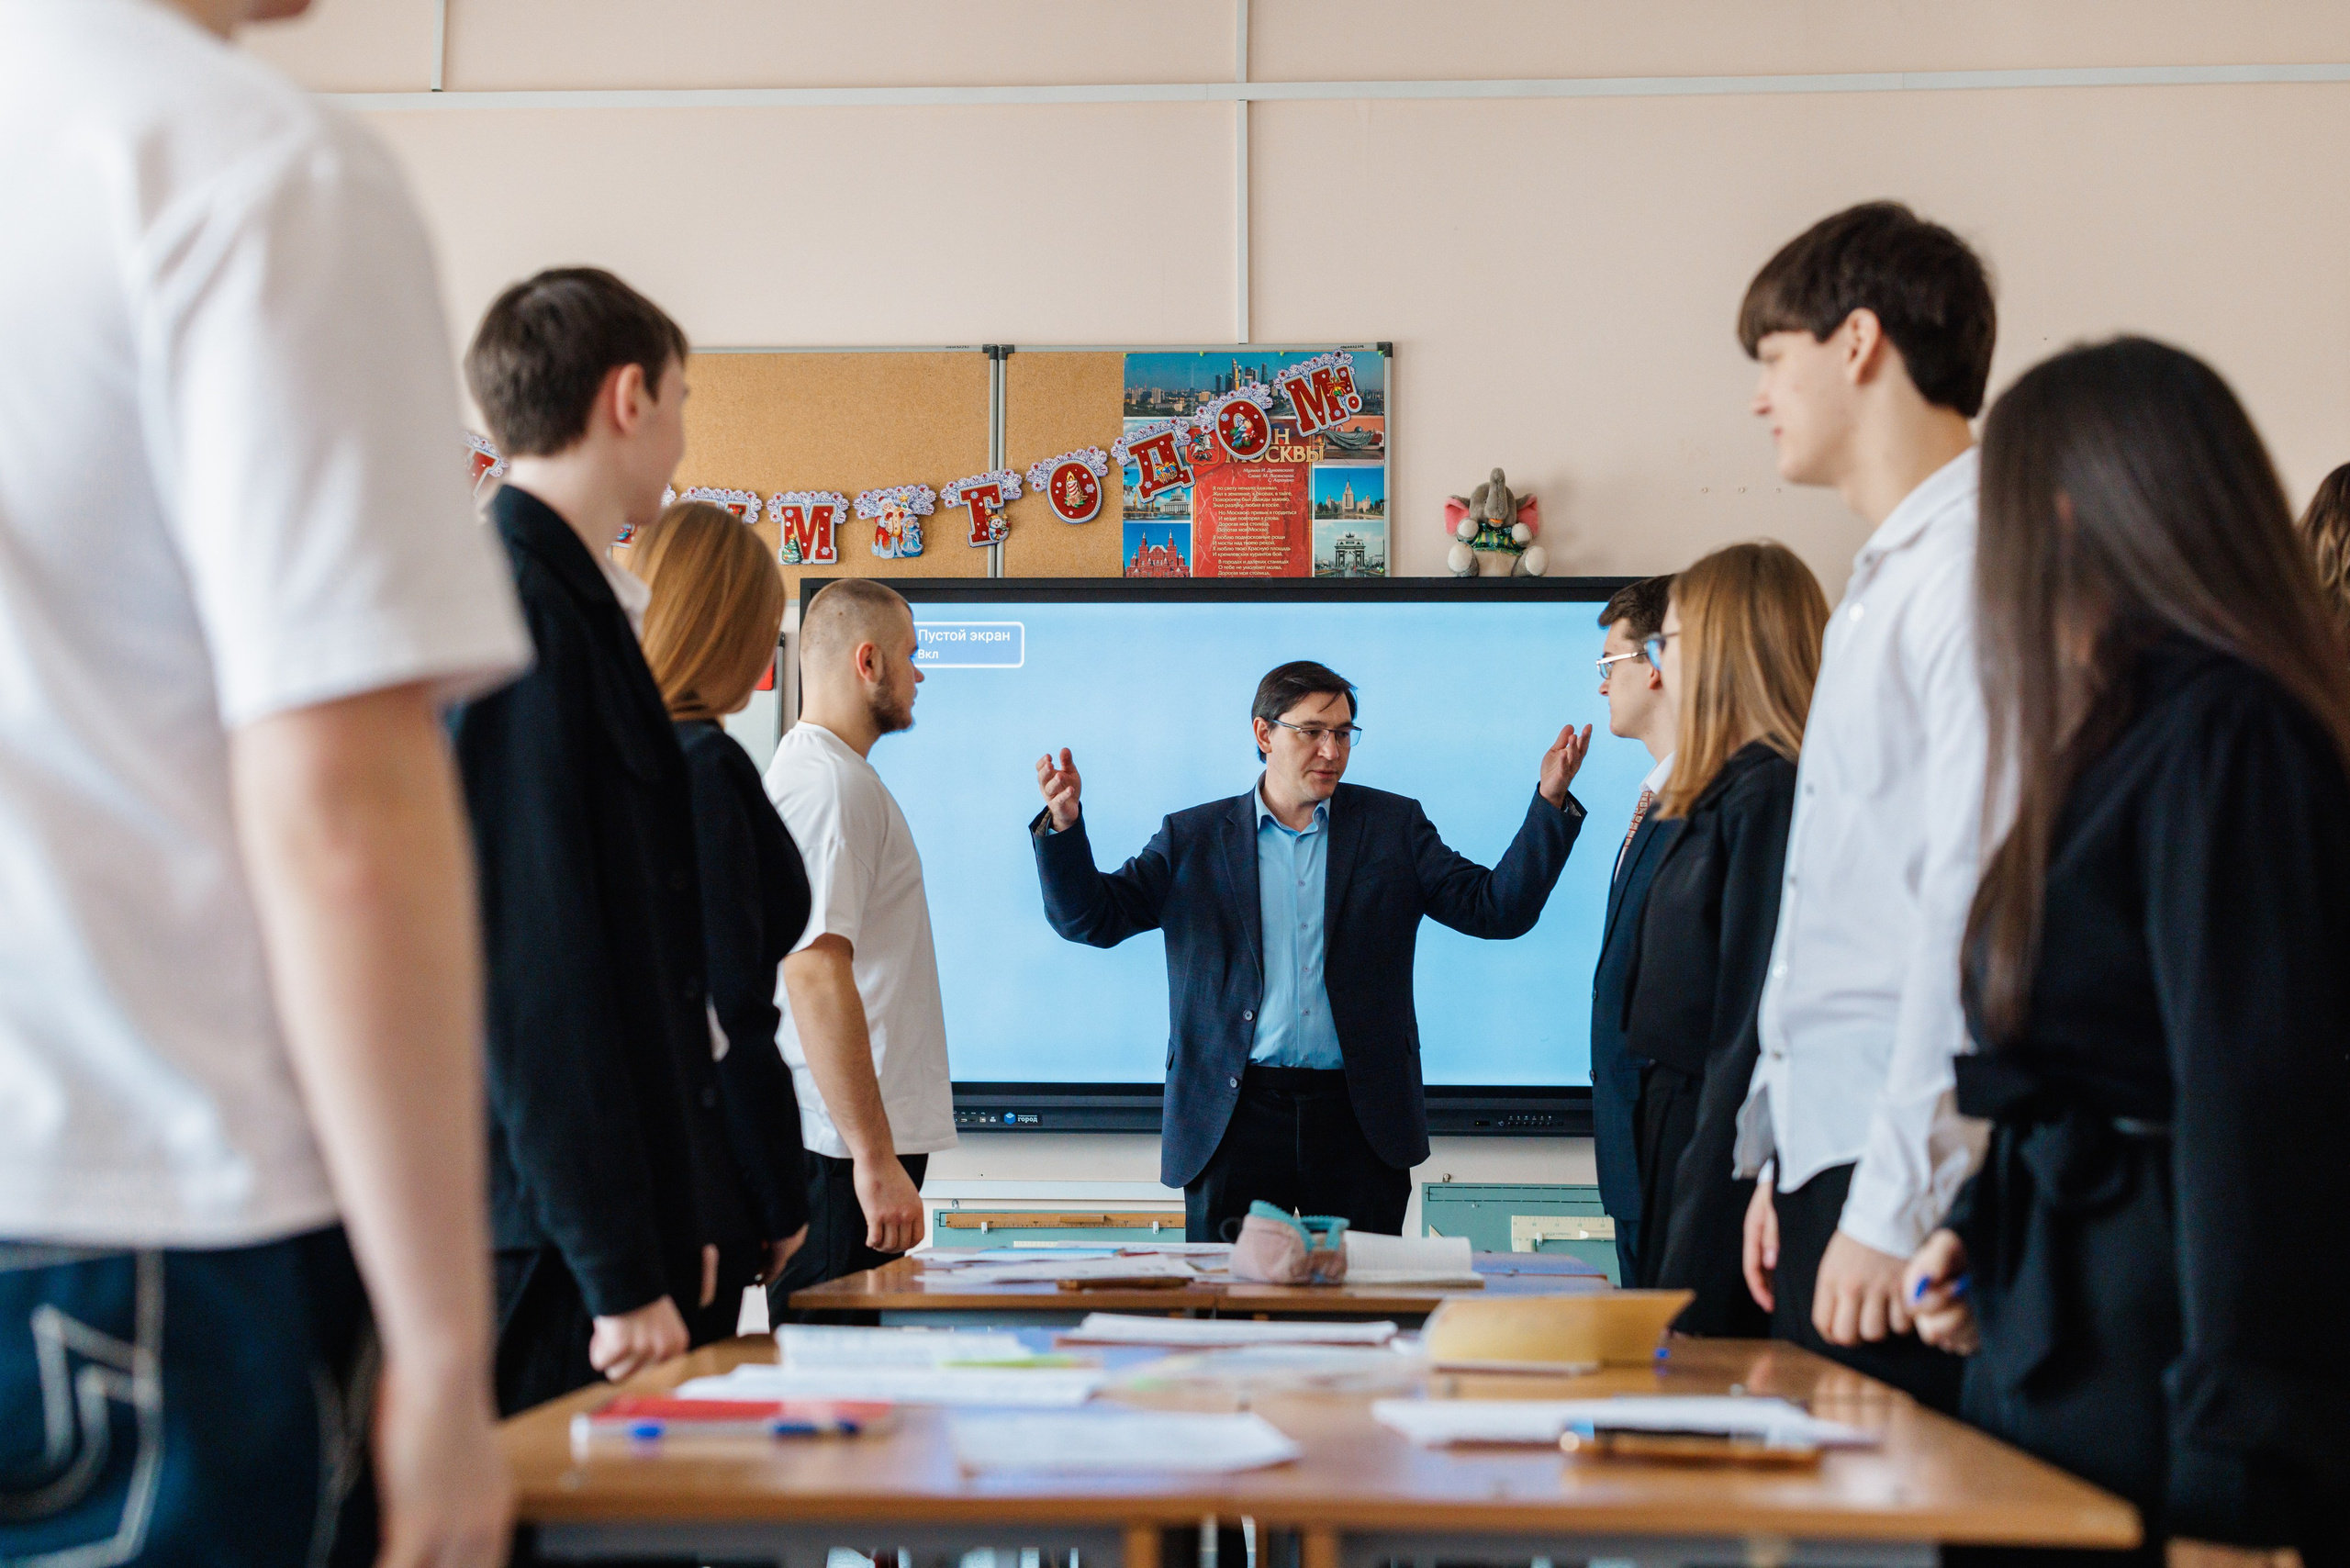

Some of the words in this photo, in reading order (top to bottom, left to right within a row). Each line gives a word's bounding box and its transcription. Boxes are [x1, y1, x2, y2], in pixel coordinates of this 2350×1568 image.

[960, 362, 1363, 548] ГОДОМ!
[918, 629, 967, 643] Пустой
[969, 631, 1010, 643] экран
[918, 649, 938, 659] Вкл
